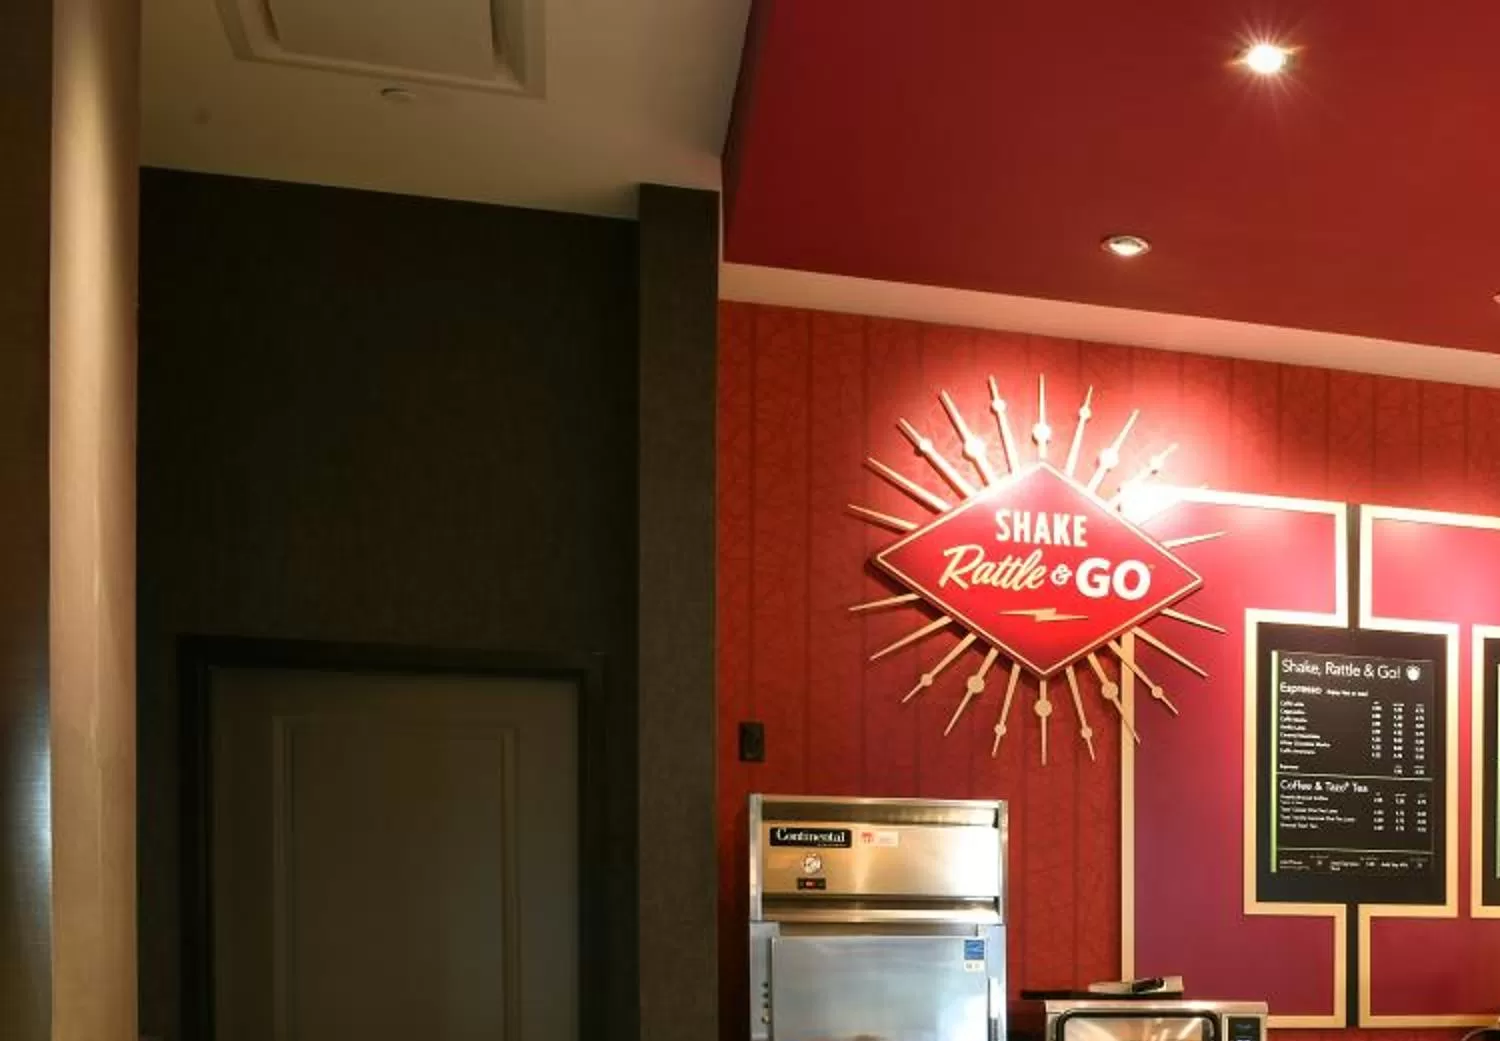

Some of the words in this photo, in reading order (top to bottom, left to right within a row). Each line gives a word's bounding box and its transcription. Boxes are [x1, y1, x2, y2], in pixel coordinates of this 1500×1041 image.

[995, 509, 1088, 548] SHAKE
[938, 543, 1048, 592] Rattle
[1050, 563, 1073, 587] &
[1074, 556, 1152, 601] GO
[1281, 658, 1322, 676] Shake,
[1325, 661, 1361, 677] Rattle
[1363, 663, 1375, 678] &
[1377, 665, 1401, 679] Go!
[776, 828, 846, 843] Continental
